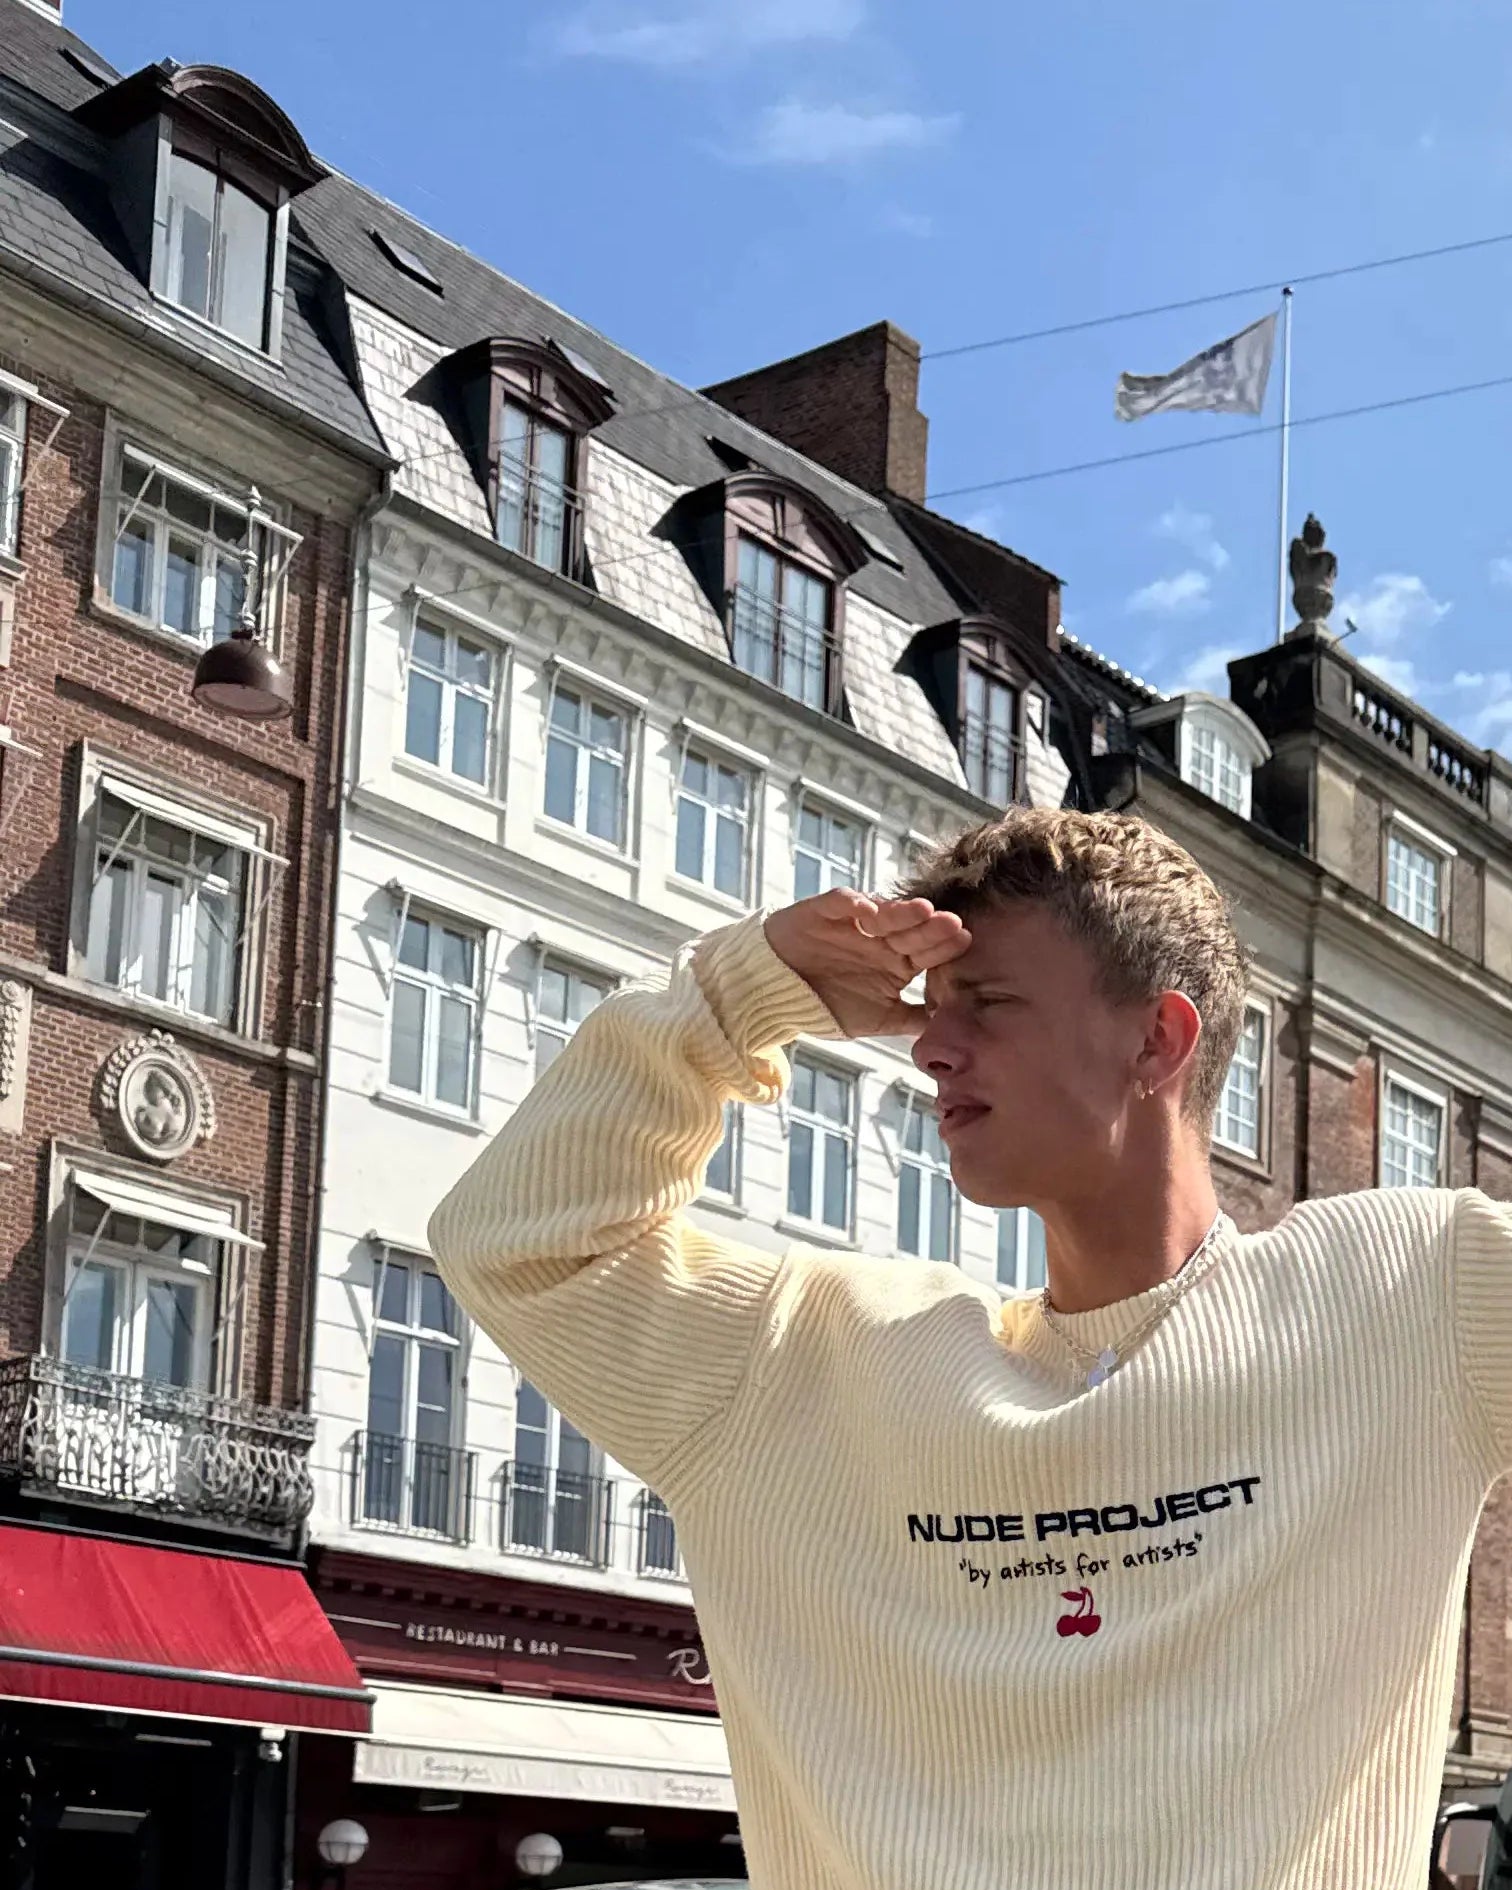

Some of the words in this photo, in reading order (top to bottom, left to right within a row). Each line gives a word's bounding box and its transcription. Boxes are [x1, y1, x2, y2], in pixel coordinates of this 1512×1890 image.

[907, 1513, 1025, 1543] NUDE
[1034, 1476, 1261, 1542] PROJECT
[1000, 1553, 1066, 1580] artists
[1076, 1552, 1110, 1580] for
[405, 1621, 505, 1650] RESTAURANT
[513, 1637, 524, 1652] &
[529, 1638, 559, 1656] BAR
